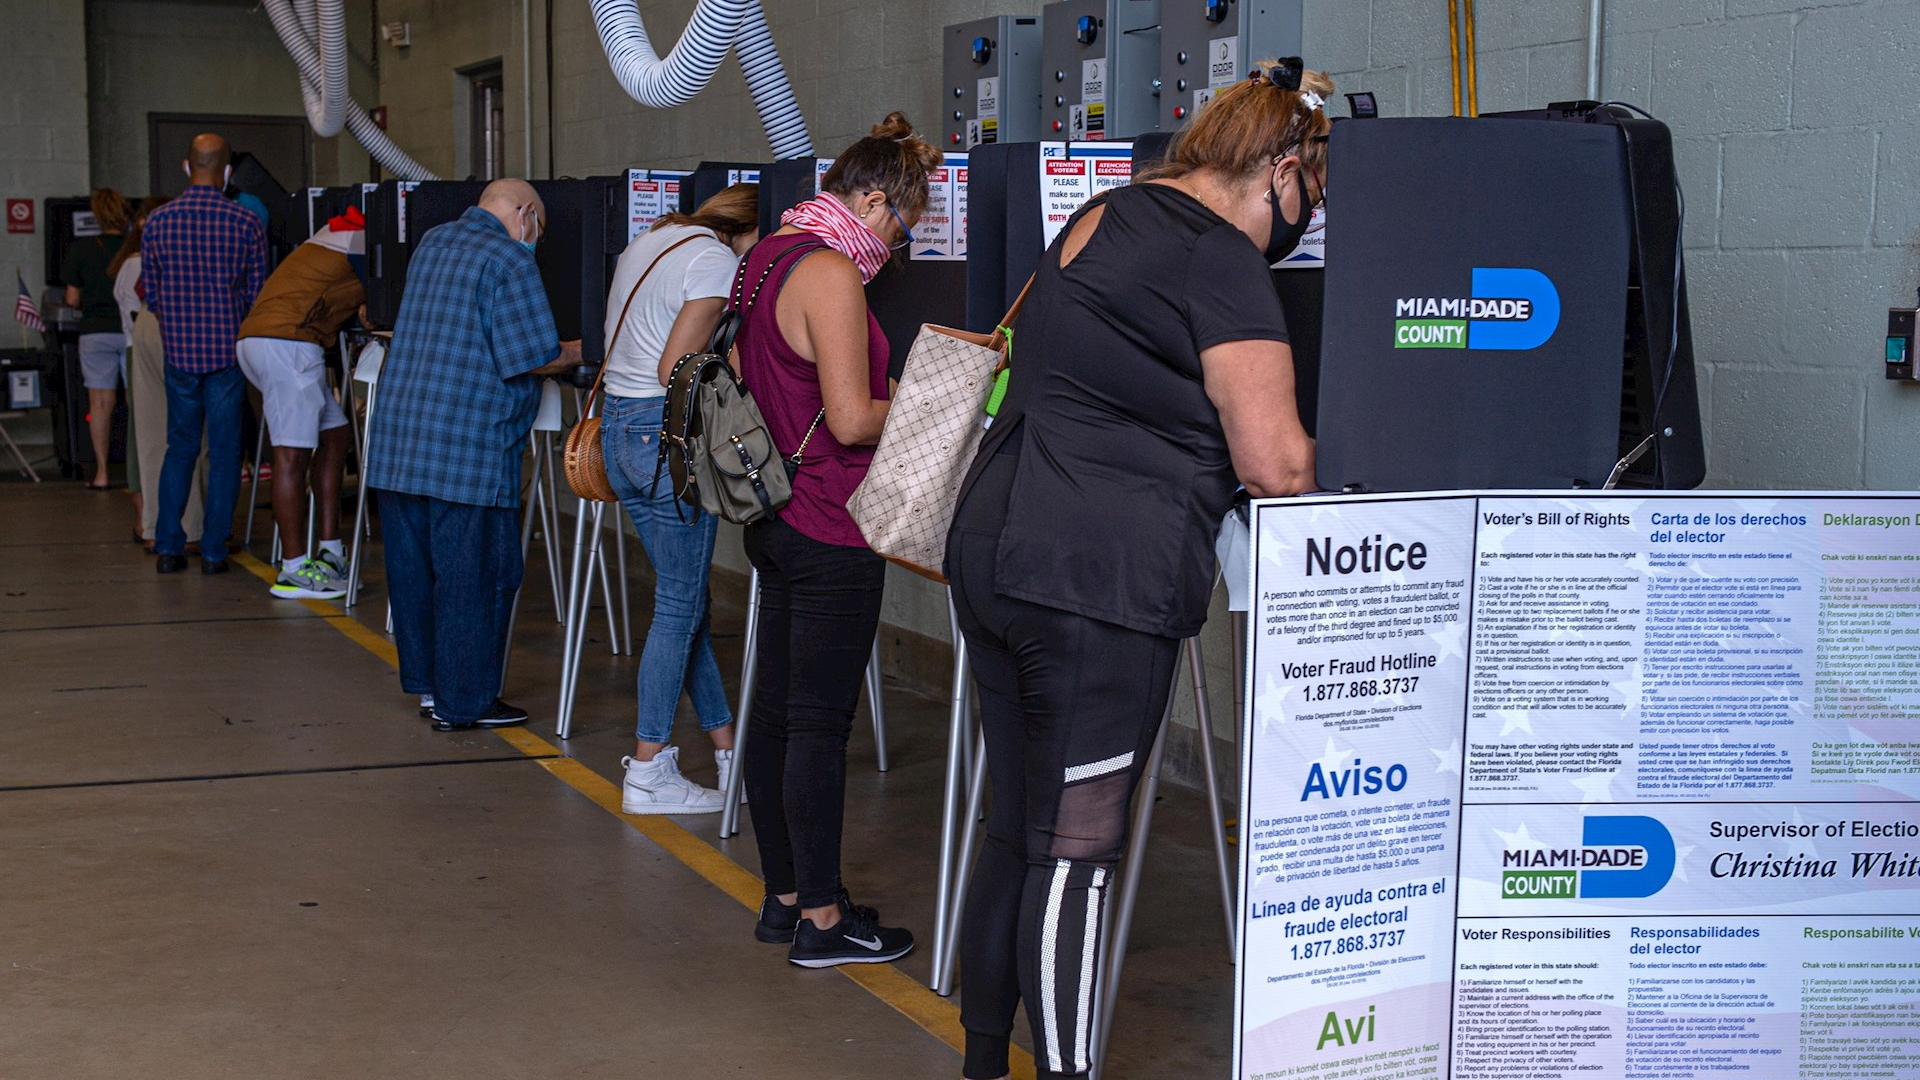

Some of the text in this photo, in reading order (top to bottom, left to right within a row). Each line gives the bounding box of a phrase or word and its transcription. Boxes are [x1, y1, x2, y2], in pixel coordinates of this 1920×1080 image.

[1213, 62, 1233, 72] DOOR
[1085, 82, 1102, 90] DOOR
[980, 98, 995, 106] DOOR
[1398, 326, 1465, 343] COUNTY
[1483, 512, 1630, 528] Voter's Bill of Rights
[1651, 513, 1807, 526] Carta de los derechos
[1824, 513, 1910, 528] Deklarasyon
[1650, 530, 1726, 543] del elector
[1306, 534, 1427, 576] Notice
[1263, 592, 1270, 600] A
[1271, 591, 1297, 602] person
[1298, 589, 1315, 598] who
[1316, 587, 1348, 597] commits
[1359, 584, 1392, 594] attempts
[1393, 583, 1401, 592] to
[1402, 582, 1429, 591] commit
[1430, 582, 1444, 591] any
[1445, 579, 1464, 588] fraud
[1267, 603, 1274, 612] in
[1276, 601, 1317, 612] connection
[1319, 599, 1334, 608] with
[1335, 599, 1360, 608] voting,
[1362, 597, 1383, 605] votes
[1390, 593, 1428, 603] fraudulent
[1429, 592, 1450, 601] ballot,
[1266, 615, 1287, 624] votes
[1310, 612, 1327, 621] than
[1328, 611, 1348, 619] once
[1349, 609, 1356, 618] in
[1369, 607, 1398, 617] election
[1414, 605, 1424, 613] be
[1425, 602, 1460, 613] convicted
[1267, 626, 1276, 636] of
[1284, 625, 1307, 635] felony
[1308, 623, 1317, 632] of
[1317, 623, 1330, 632] the
[1331, 621, 1348, 631] third
[1349, 621, 1376, 631] degree
[1377, 618, 1392, 627] and
[1393, 617, 1411, 626] fined
[1413, 618, 1423, 626] up
[1433, 613, 1458, 624] $5,000
[1297, 635, 1322, 645] and/or
[1323, 632, 1364, 644] imprisoned
[1365, 631, 1376, 640] for
[1377, 632, 1387, 640] up
[1397, 629, 1403, 638] 5
[1404, 629, 1426, 639] years.
[1281, 653, 1436, 680] Voter Fraud Hotline
[1304, 676, 1419, 702] 1.877.868.3737
[1315, 711, 1346, 720] Department
[1300, 758, 1408, 802] Aviso
[1254, 819, 1270, 828] Una
[1272, 816, 1302, 828] persona
[1304, 814, 1318, 823] que
[1320, 810, 1349, 820] cometa,
[1358, 806, 1383, 815] intente
[1384, 803, 1415, 813] cometer,
[1428, 798, 1451, 807] fraude
[1710, 821, 1820, 842] Supervisor
[1826, 821, 1846, 837] of
[1710, 852, 1837, 878] Christina
[1504, 876, 1574, 895] COUNTY
[1252, 878, 1446, 919] Línea de ayuda contra el
[1284, 906, 1408, 938] fraude electoral
[1462, 928, 1611, 942] Voter Responsibilities
[1631, 926, 1760, 941] Responsabilidades
[1804, 926, 1904, 941] Responsabilite
[1291, 929, 1405, 961] 1.877.868.3737
[1630, 943, 1702, 954] del elector
[1316, 1005, 1376, 1051] Avi
